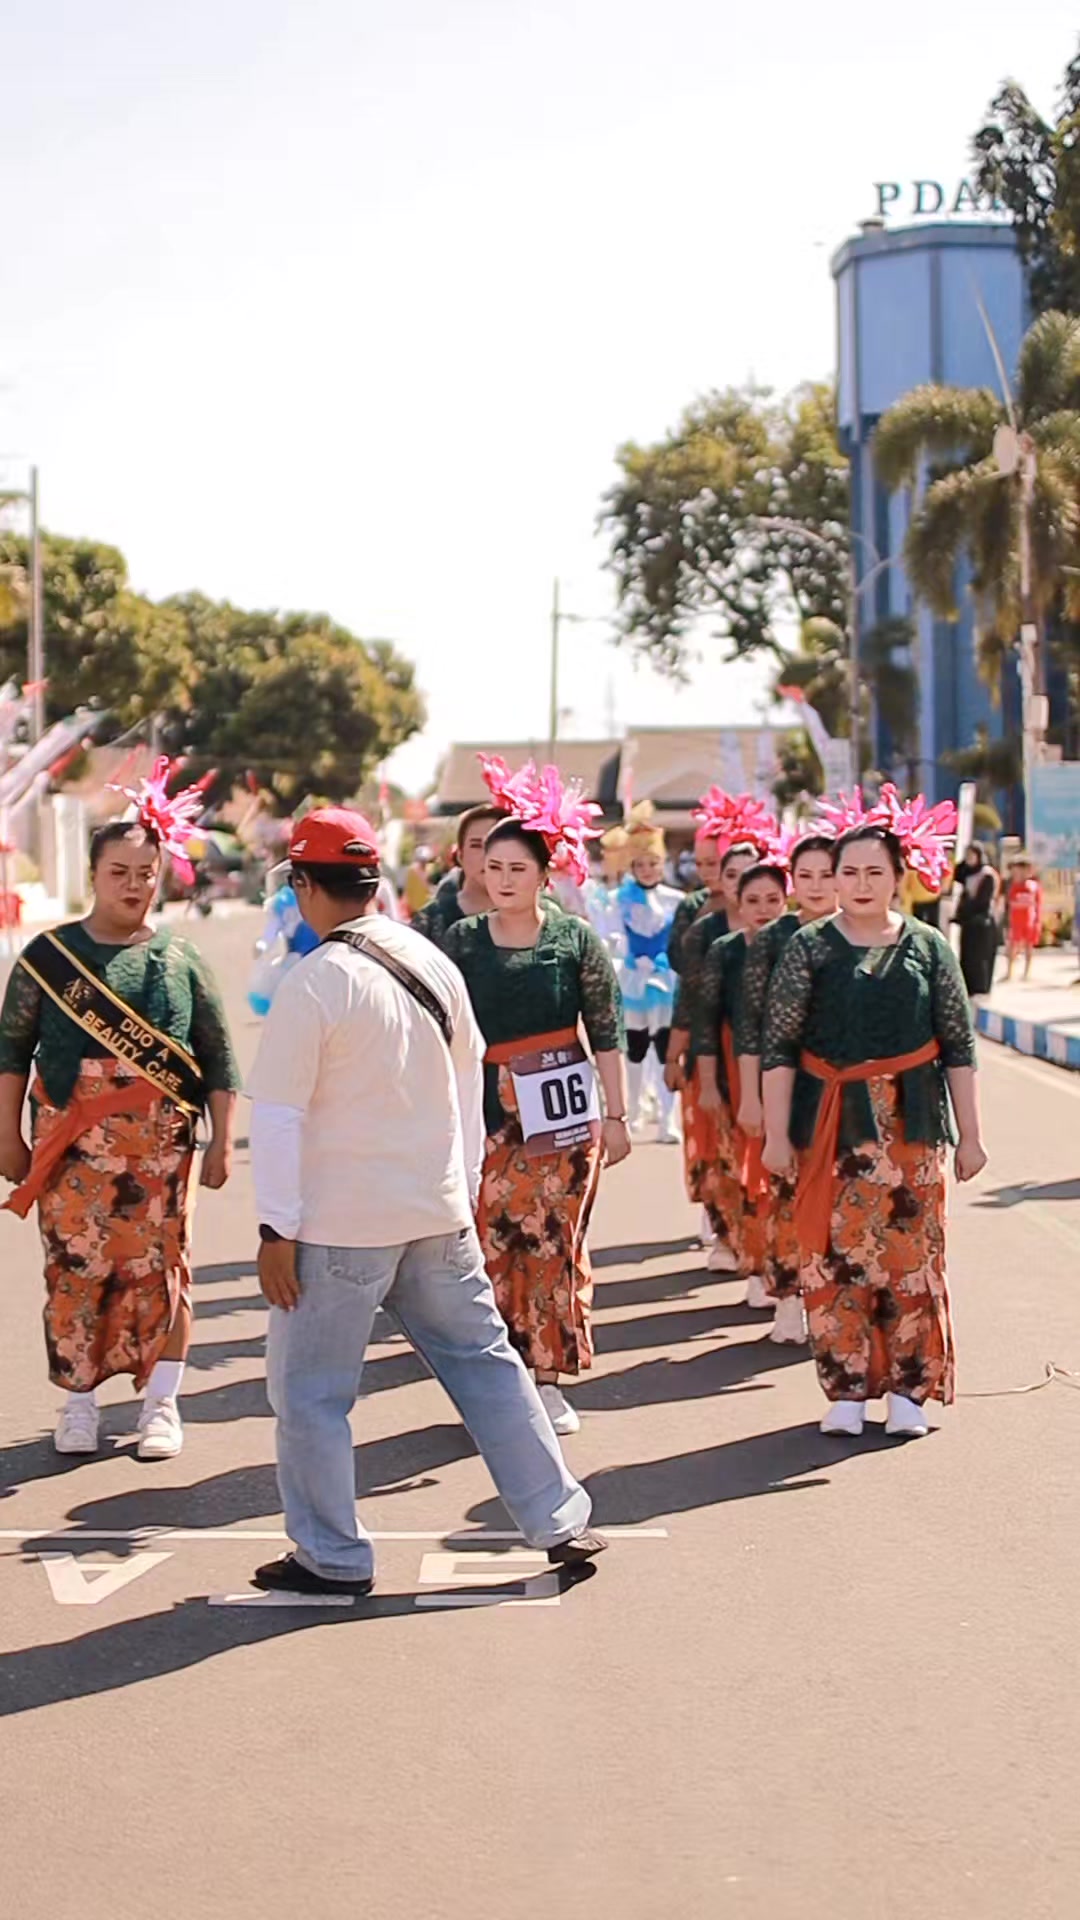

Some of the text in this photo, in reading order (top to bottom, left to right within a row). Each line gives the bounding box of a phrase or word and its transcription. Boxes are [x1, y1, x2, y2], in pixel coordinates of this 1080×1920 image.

[82, 1010, 183, 1091] BEAUTY CARE
[120, 1017, 169, 1062] DUO A
[541, 1073, 587, 1121] 06
